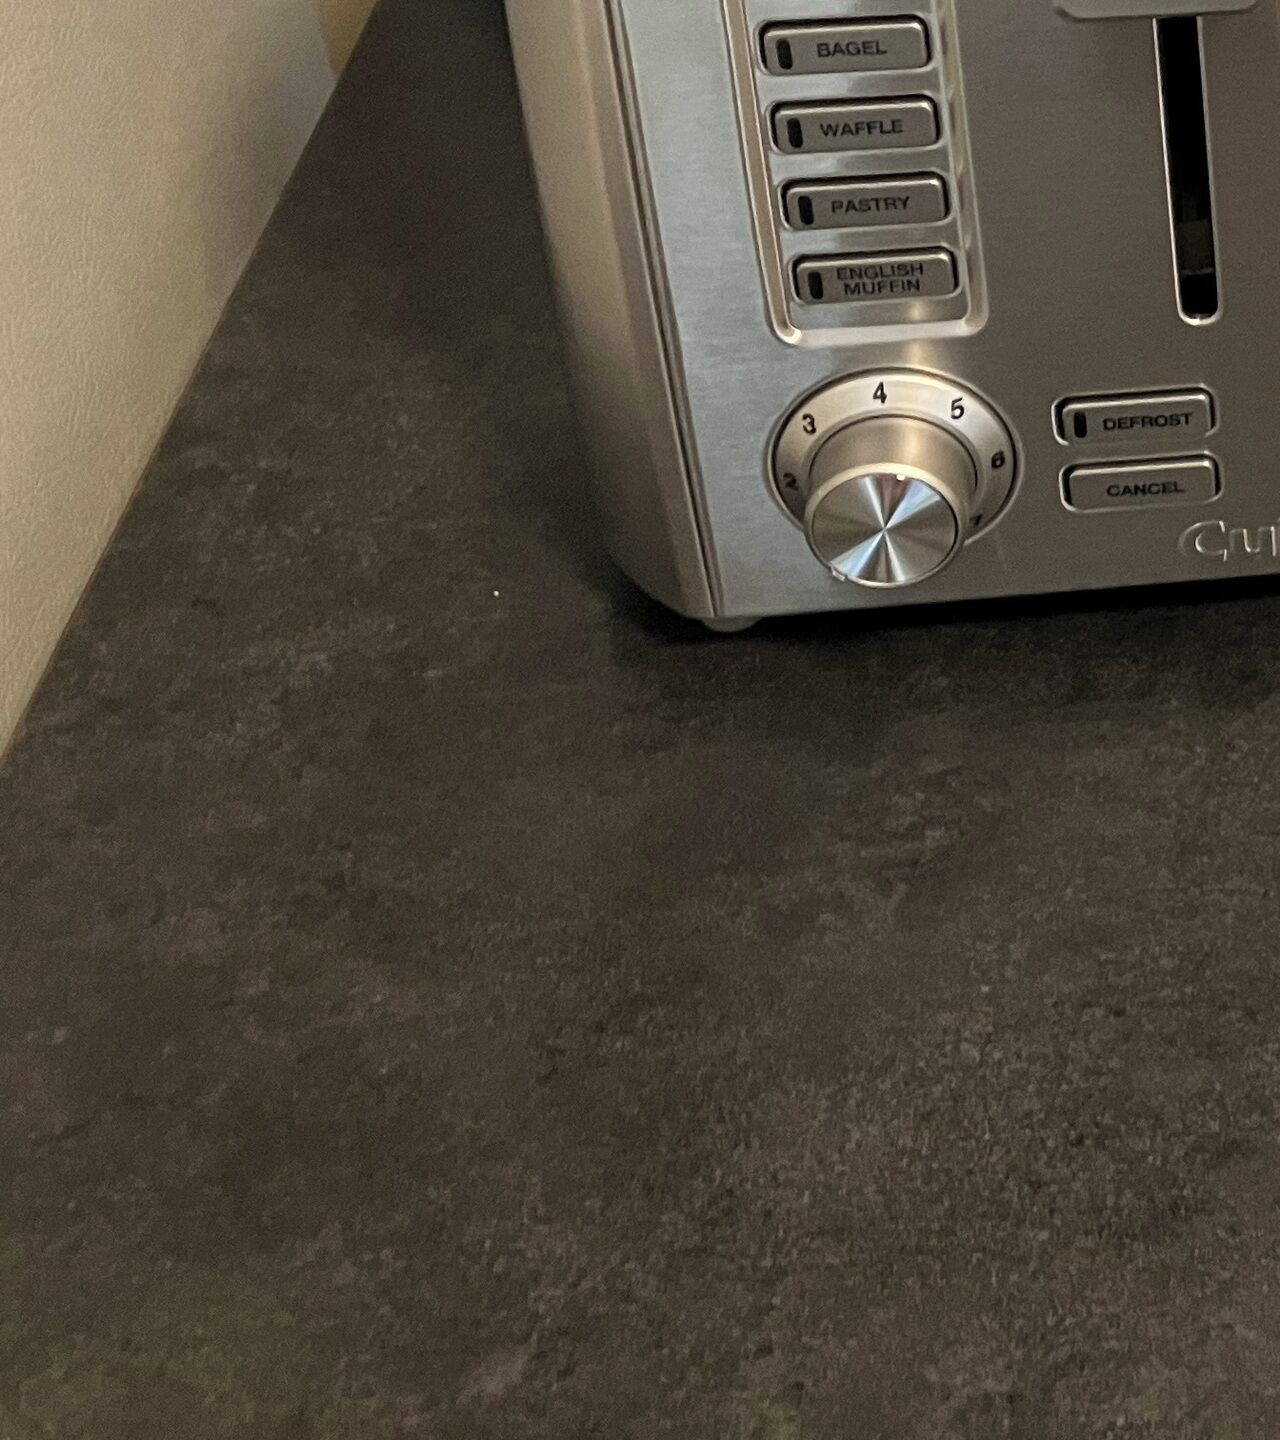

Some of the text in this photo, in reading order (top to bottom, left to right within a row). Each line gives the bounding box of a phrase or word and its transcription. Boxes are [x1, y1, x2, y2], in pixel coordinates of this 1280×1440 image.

[816, 39, 888, 58] BAGEL
[819, 119, 905, 137] WAFFLE
[831, 195, 911, 214] PASTRY
[836, 263, 924, 281] ENGLISH
[843, 280, 921, 297] MUFFIN
[872, 382, 888, 405] 4
[951, 397, 965, 420] 5
[802, 414, 817, 435] 3
[1103, 412, 1193, 431] DEFROST
[1106, 480, 1186, 497] CANCEL
